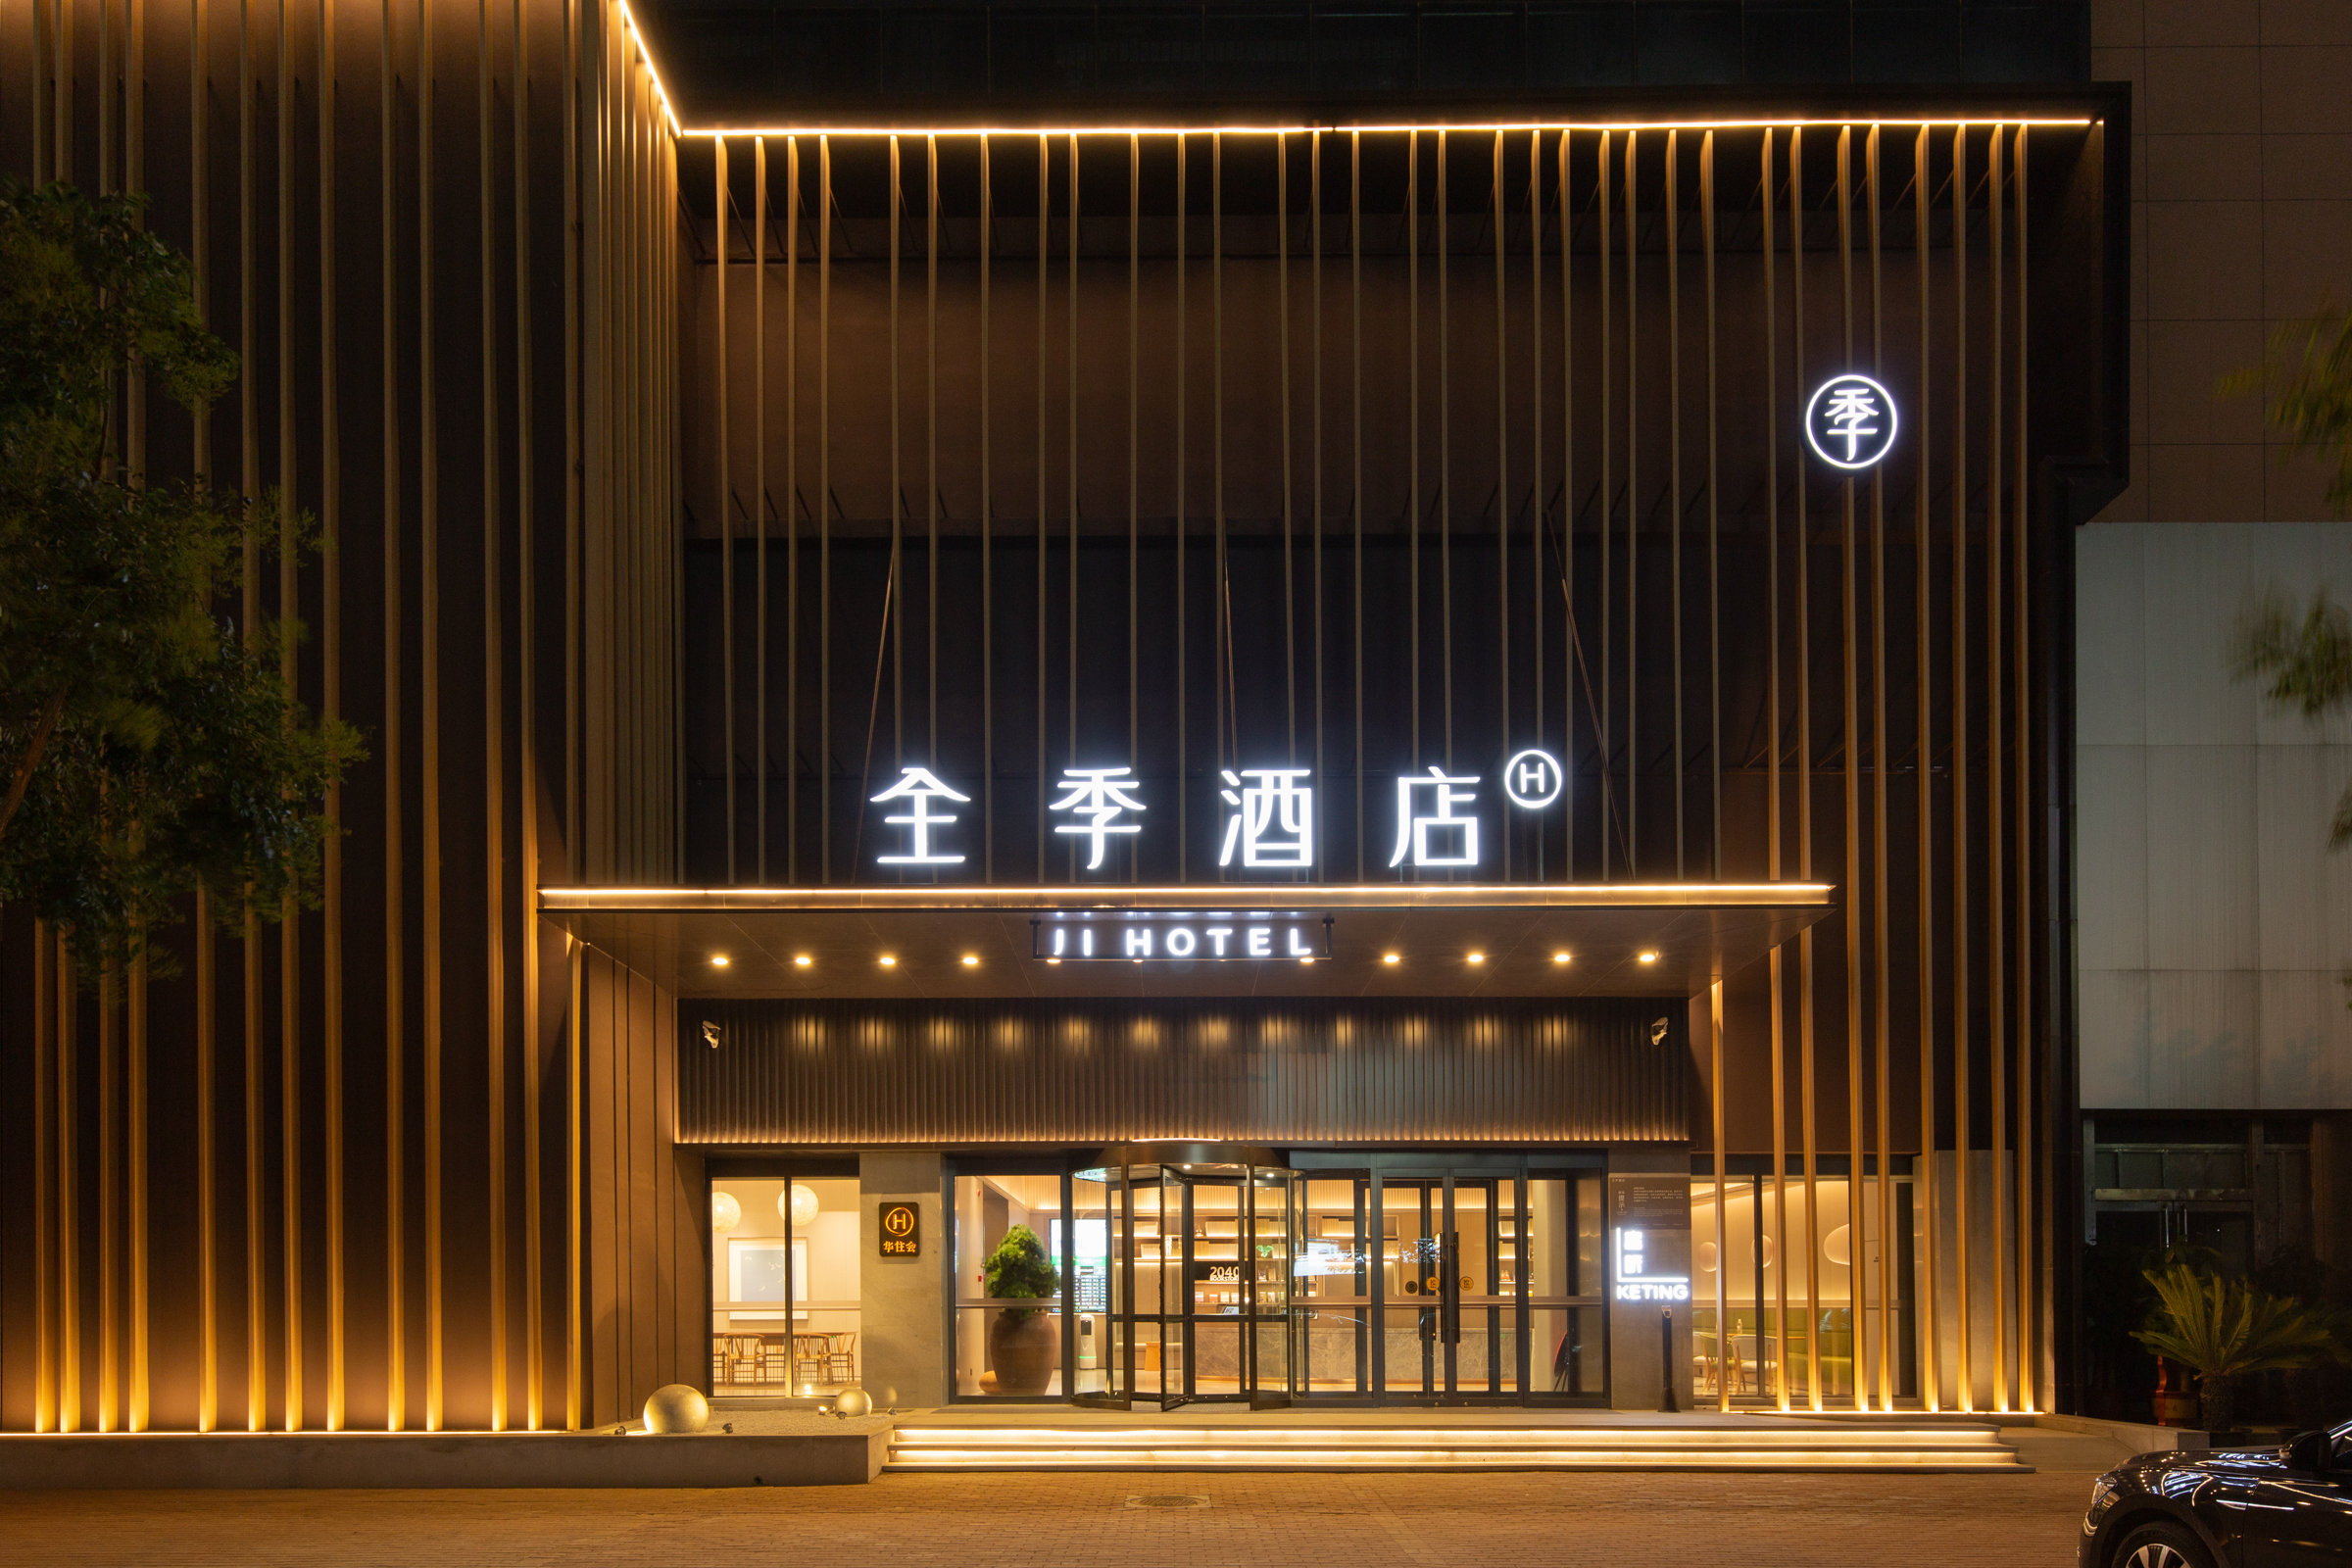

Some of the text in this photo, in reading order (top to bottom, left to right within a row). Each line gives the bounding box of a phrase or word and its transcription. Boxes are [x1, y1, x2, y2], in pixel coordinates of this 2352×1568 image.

[1824, 388, 1880, 462] 季
[870, 766, 1480, 869] 全季酒店
[1054, 928, 1311, 956] JI HOTEL
[883, 1240, 917, 1253] 华住会
[1209, 1265, 1240, 1278] 2040
[1616, 1284, 1690, 1300] KETING
